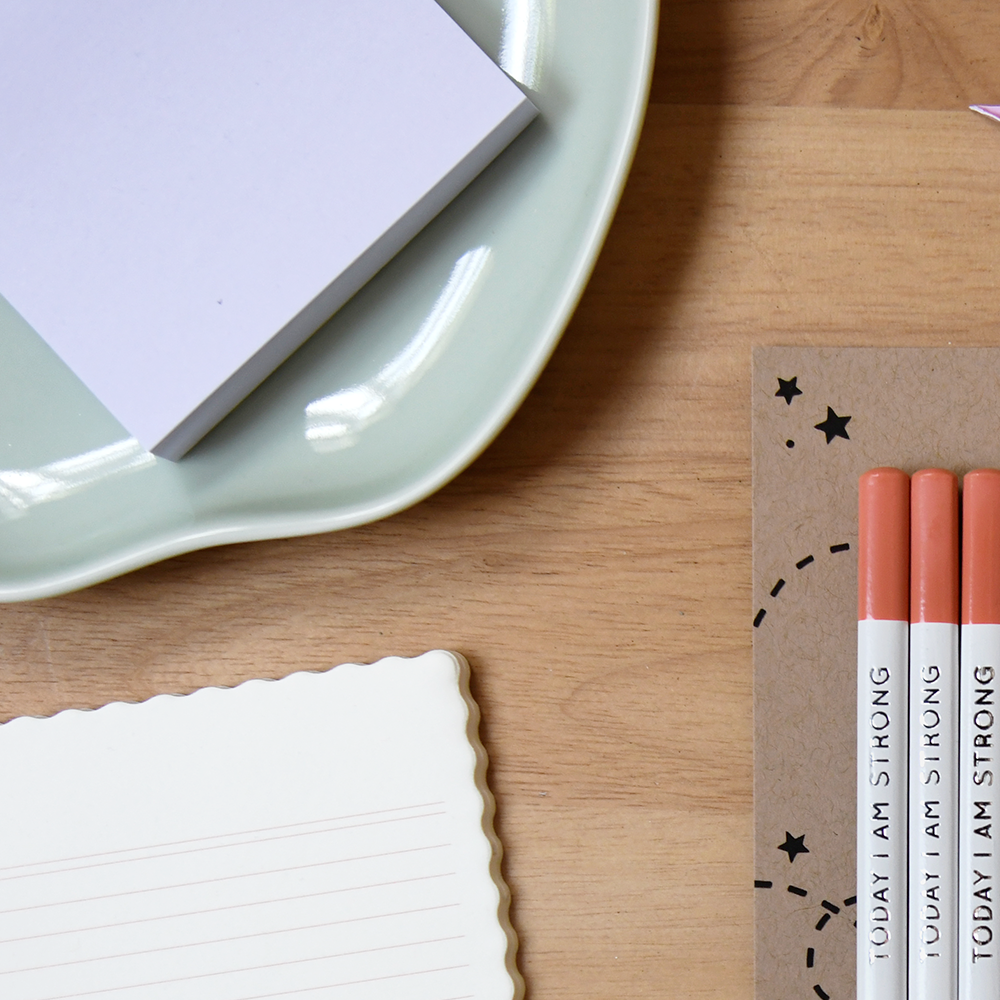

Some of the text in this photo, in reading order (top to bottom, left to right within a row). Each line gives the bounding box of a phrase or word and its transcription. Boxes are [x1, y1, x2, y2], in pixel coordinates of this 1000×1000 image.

[869, 665, 891, 787] STRONG
[972, 665, 995, 787] STRONG
[873, 802, 890, 840] AM
[924, 800, 941, 839] AM
[973, 800, 993, 840] AM
[868, 872, 891, 965] TODAY
[972, 869, 993, 964] TODAY
